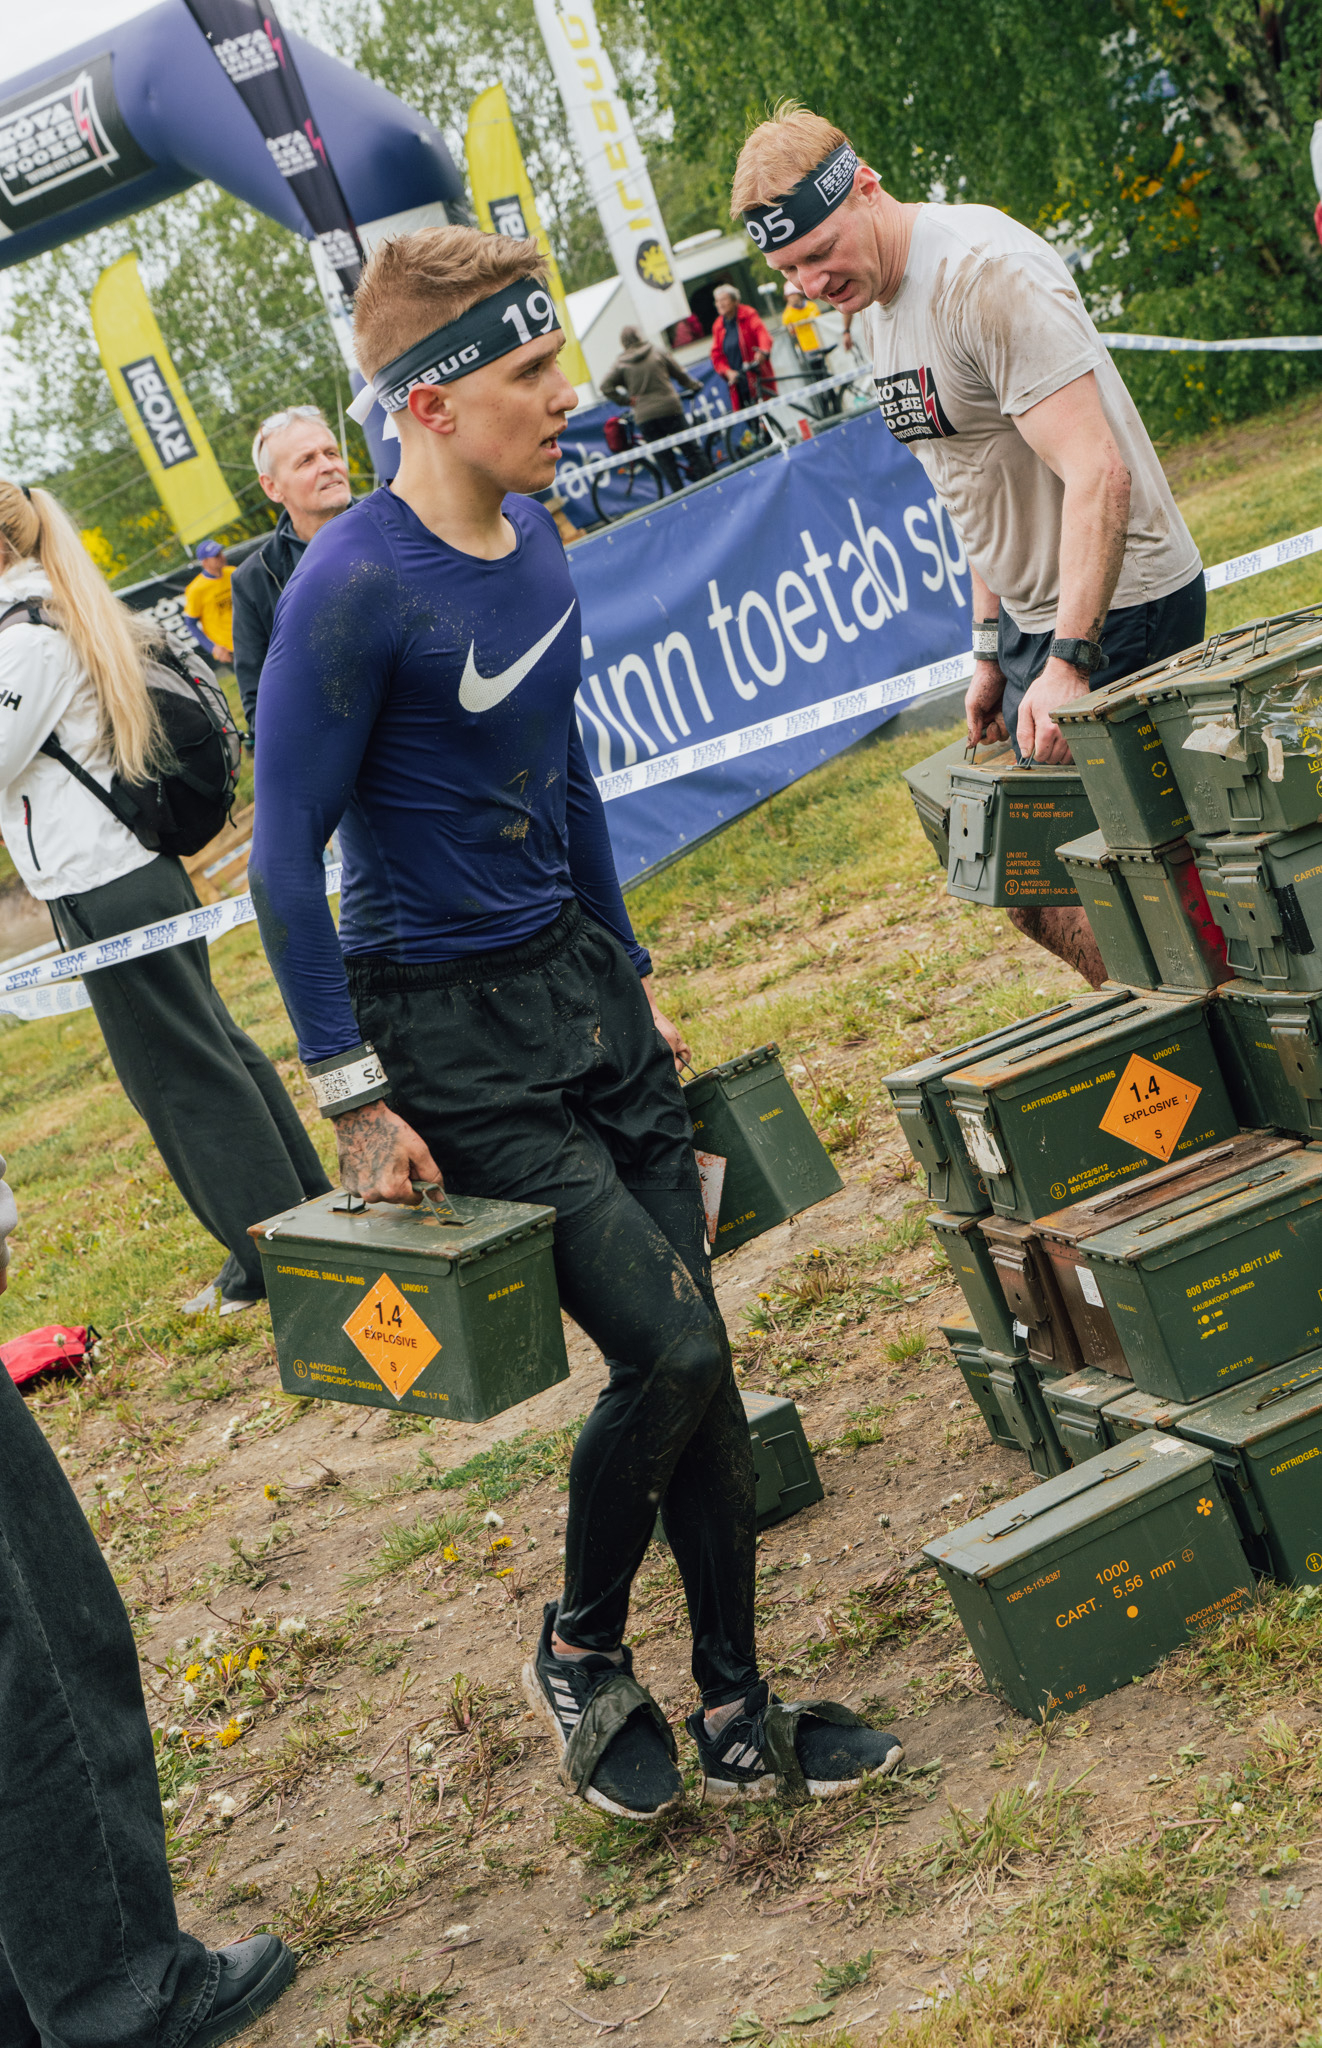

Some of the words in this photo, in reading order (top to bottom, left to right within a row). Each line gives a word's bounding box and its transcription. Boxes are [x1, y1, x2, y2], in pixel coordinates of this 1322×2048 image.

[127, 362, 191, 463] RYOBI
[708, 498, 908, 700] toetab
[1137, 724, 1152, 737] 100
[1021, 811, 1029, 819] Kg
[189, 906, 222, 926] TERVE
[144, 921, 178, 942] TERVE
[98, 936, 132, 956] TERVE
[53, 951, 87, 970] TERVE
[7, 966, 41, 985] TERVE
[1152, 1044, 1181, 1061] UN0012
[1021, 1090, 1070, 1113] CARTRIDGES,
[1070, 1079, 1094, 1096] SMALL
[1095, 1070, 1116, 1085] ARMS
[1129, 1075, 1160, 1103] 1.4
[1123, 1096, 1179, 1124] EXPLOSIVE
[1154, 1129, 1162, 1139] S
[1177, 1139, 1195, 1151] NEQ:
[1204, 1129, 1215, 1139] KG
[1160, 1145, 1166, 1154] 1
[1067, 1163, 1109, 1185] 4A/Y22/S/12
[1070, 1158, 1148, 1195] BR/CBC/DPC-139/2010
[718, 1222, 735, 1234] NEQ:
[744, 1210, 756, 1220] KG
[277, 1265, 321, 1280] CARTRIDGES,
[322, 1271, 344, 1283] SMALL
[345, 1276, 365, 1286] ARMS
[1186, 1284, 1201, 1298] 800
[1202, 1277, 1221, 1291] RDS
[1222, 1270, 1239, 1285] 5,56
[1240, 1257, 1263, 1274] 4B/1T
[1264, 1249, 1283, 1265] LNK
[401, 1282, 429, 1294] UN0012
[488, 1293, 497, 1301] Rd
[509, 1281, 525, 1293] BALL
[1192, 1291, 1229, 1312] KAUBAKOOD
[375, 1301, 402, 1328] 1.4
[1217, 1322, 1229, 1332] M27
[364, 1329, 418, 1349] EXPLOSIVE
[309, 1361, 347, 1376] 4A/Y22/S/12
[390, 1361, 397, 1372] S
[1217, 1366, 1229, 1377] CBC
[1230, 1360, 1243, 1371] 0412
[1243, 1355, 1254, 1365] 136
[393, 1380, 398, 1391] 1
[412, 1389, 428, 1399] NEQ:
[438, 1392, 449, 1401] KG
[1095, 1559, 1130, 1585] 1000
[1006, 1570, 1061, 1604] 1305-15-113-8387
[1055, 1597, 1103, 1628] CART.
[1112, 1574, 1143, 1599] 5,56
[1149, 1559, 1176, 1580] mm
[1185, 1604, 1213, 1625] FIOCCHI
[1199, 1611, 1222, 1630] LECCO
[1065, 1690, 1074, 1701] 10
[1077, 1684, 1087, 1694] 22
